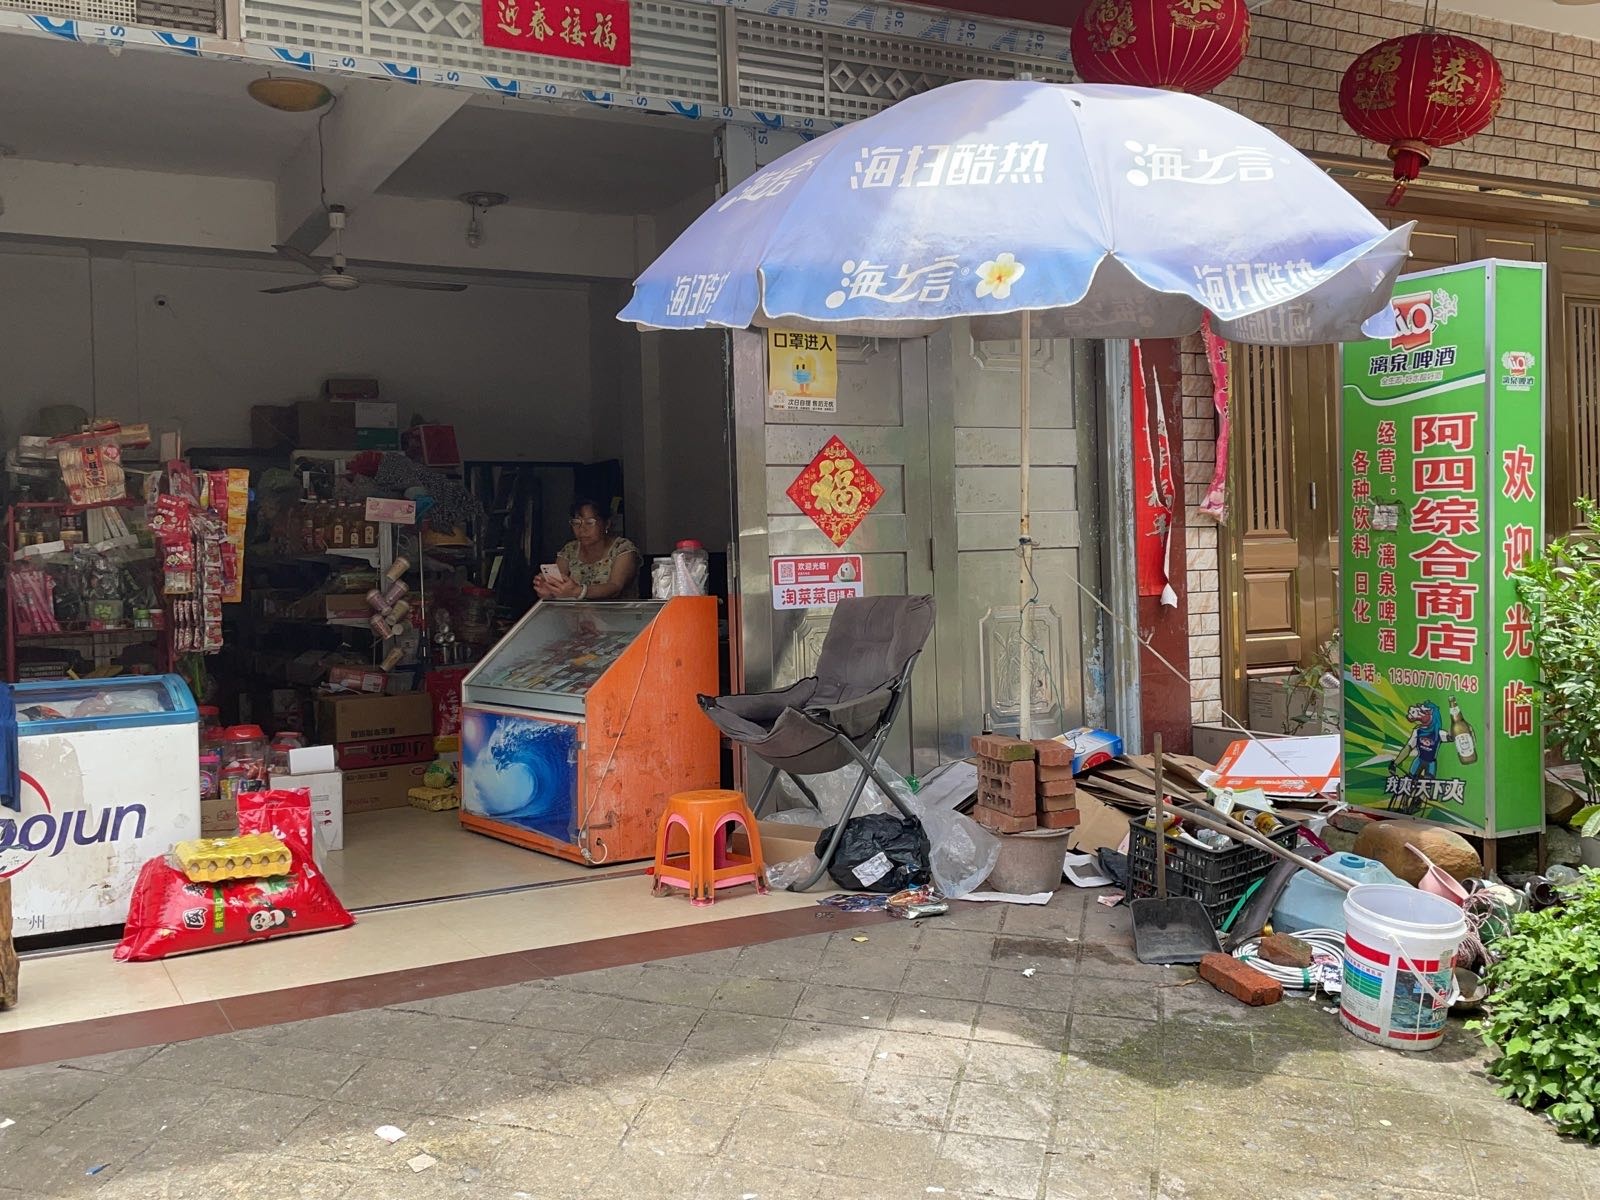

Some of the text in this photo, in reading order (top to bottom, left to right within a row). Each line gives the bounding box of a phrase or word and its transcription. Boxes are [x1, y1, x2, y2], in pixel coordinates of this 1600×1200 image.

[497, 0, 618, 51] 迎春接福
[849, 140, 1048, 190] 海扫酷热
[1124, 140, 1276, 187] 海之言
[825, 255, 960, 309] 海之言
[774, 332, 833, 351] 口罩进入
[1370, 347, 1456, 374] 漓泉啤酒
[810, 459, 862, 515] 福
[1352, 450, 1371, 623] 各种饮料 日化
[1409, 413, 1480, 664] 阿四综合商店
[781, 587, 826, 606] 淘菜菜
[1377, 544, 1396, 653] 漓泉啤酒
[1503, 446, 1535, 737] 欢迎光临
[1388, 668, 1479, 693] 13507707148
